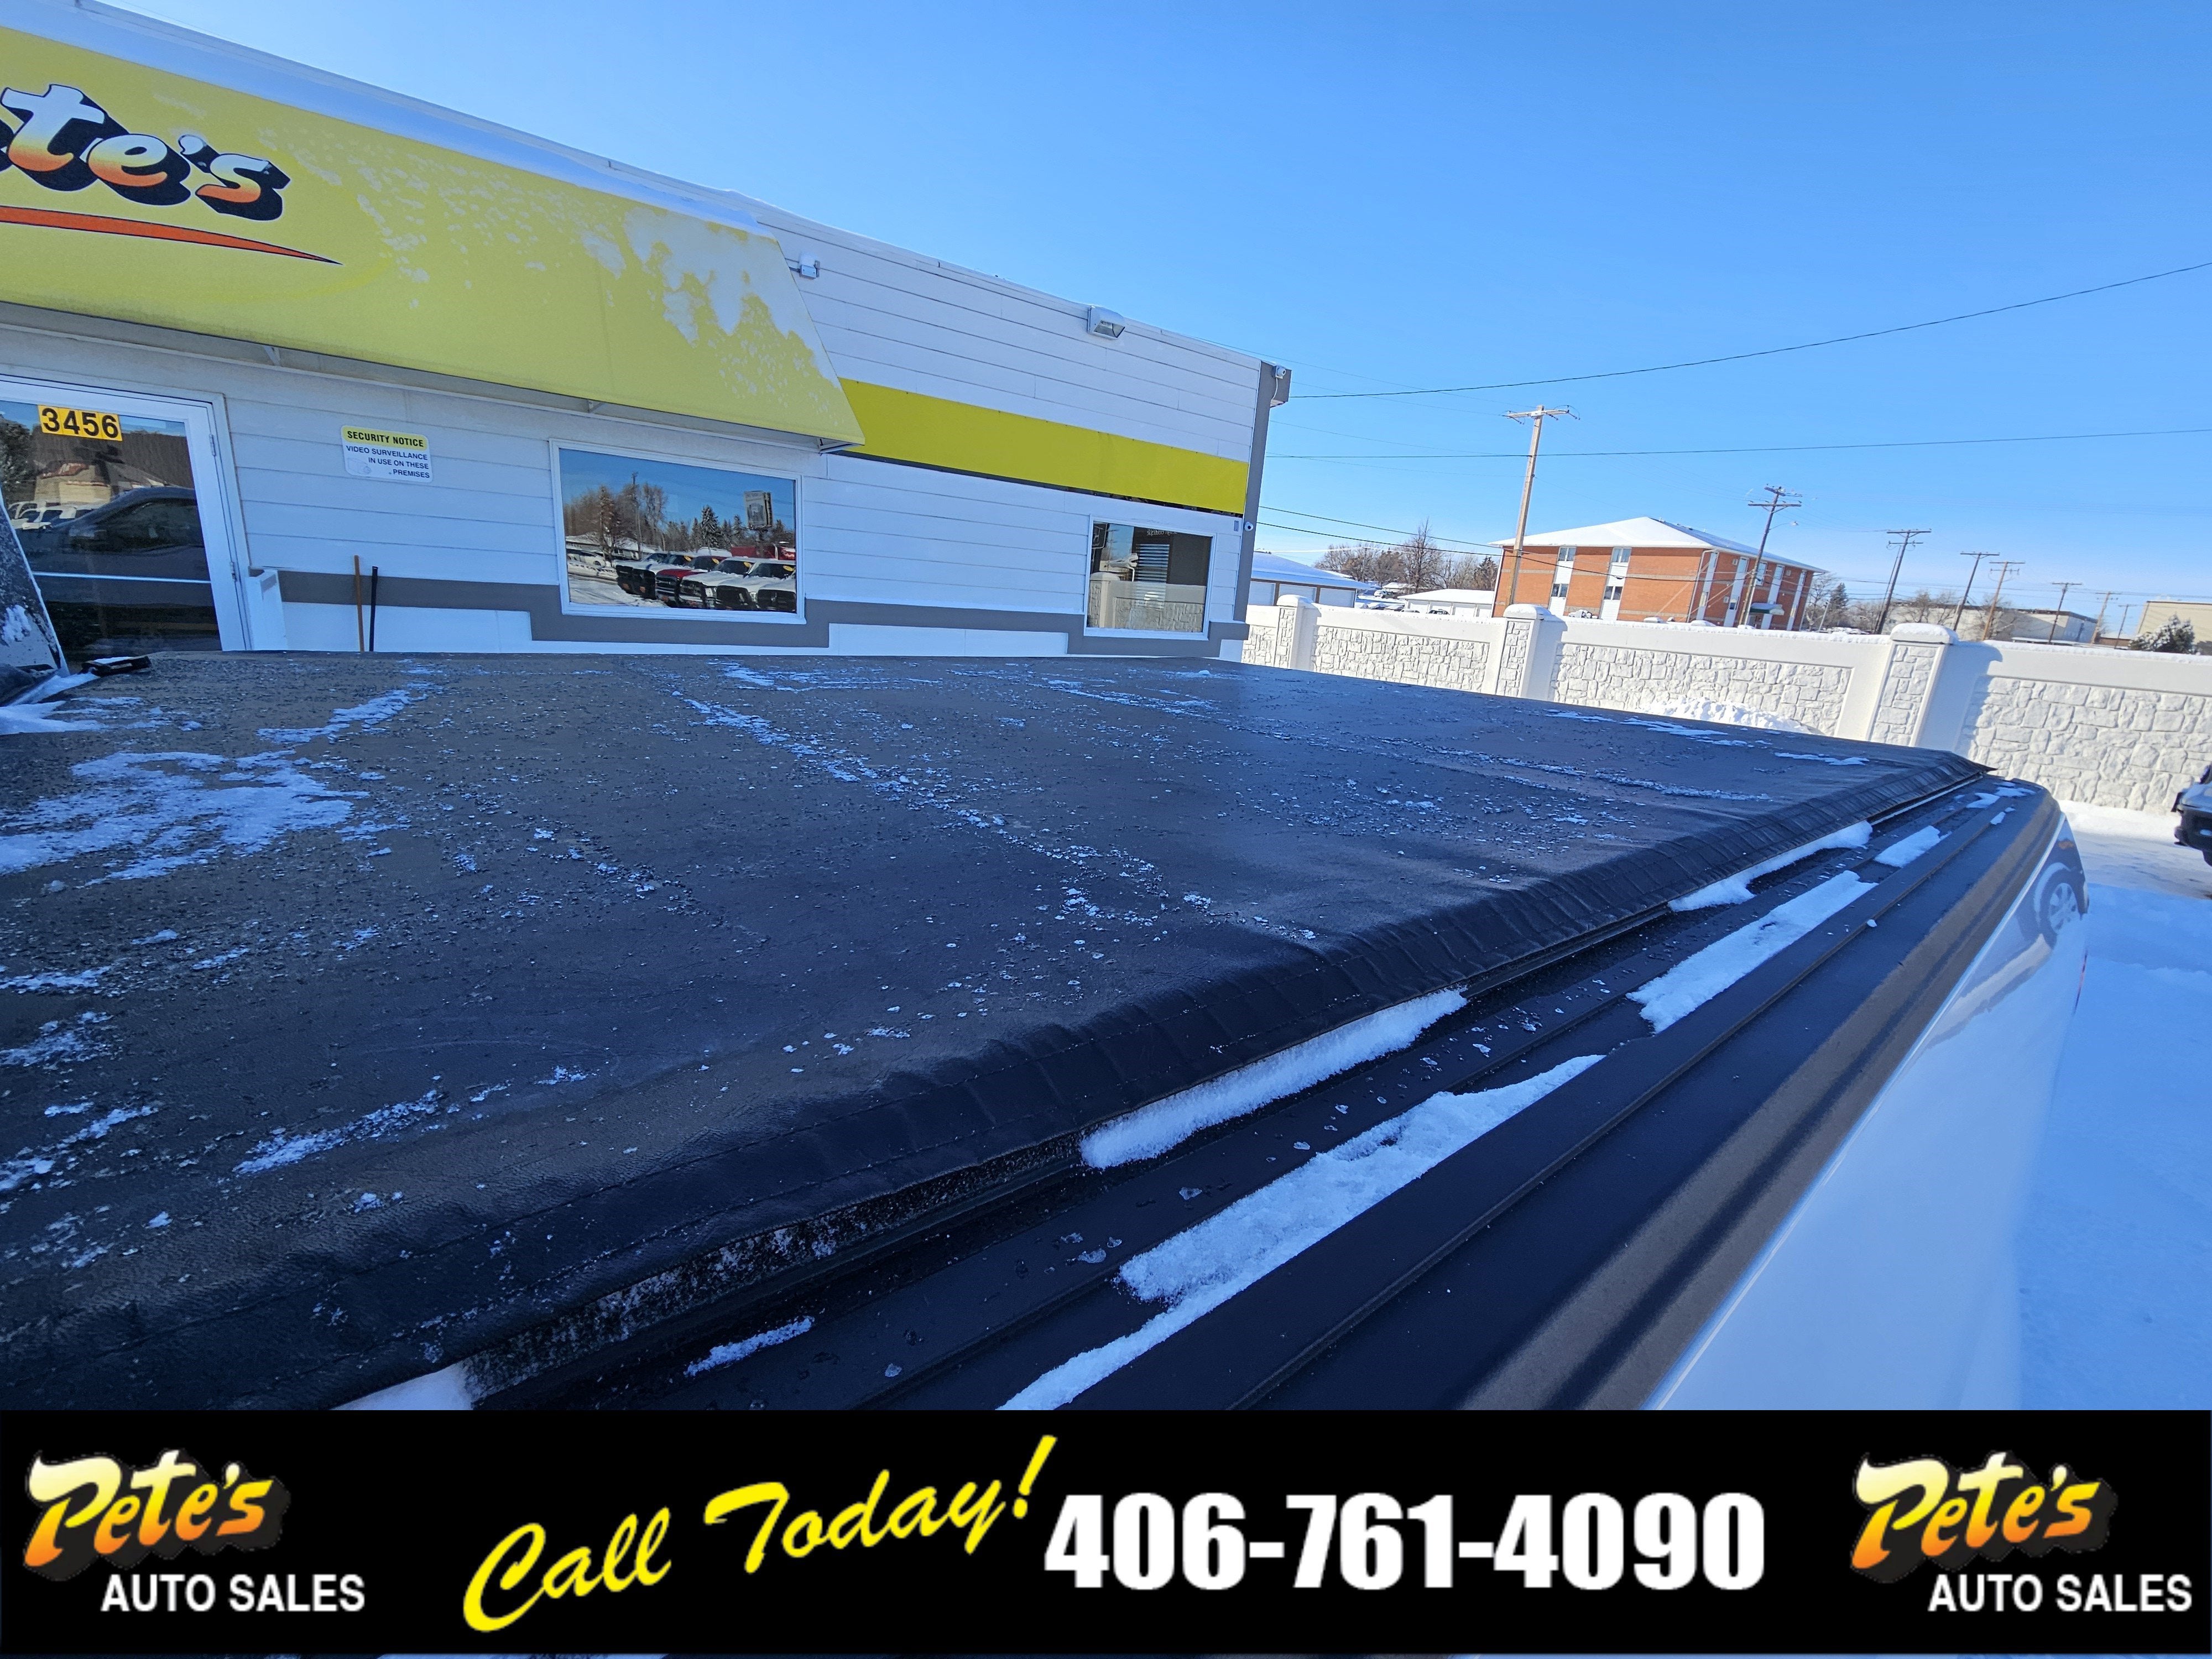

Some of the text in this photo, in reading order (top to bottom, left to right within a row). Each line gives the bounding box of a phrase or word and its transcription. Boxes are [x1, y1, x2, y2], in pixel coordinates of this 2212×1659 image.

[0, 84, 286, 220] te's
[41, 408, 119, 439] 3456
[347, 431, 424, 447] SECURITY NOTICE
[346, 445, 428, 460] VIDEO SURVEILLANCE
[405, 461, 429, 469] THESE
[393, 468, 430, 478] PREMISES
